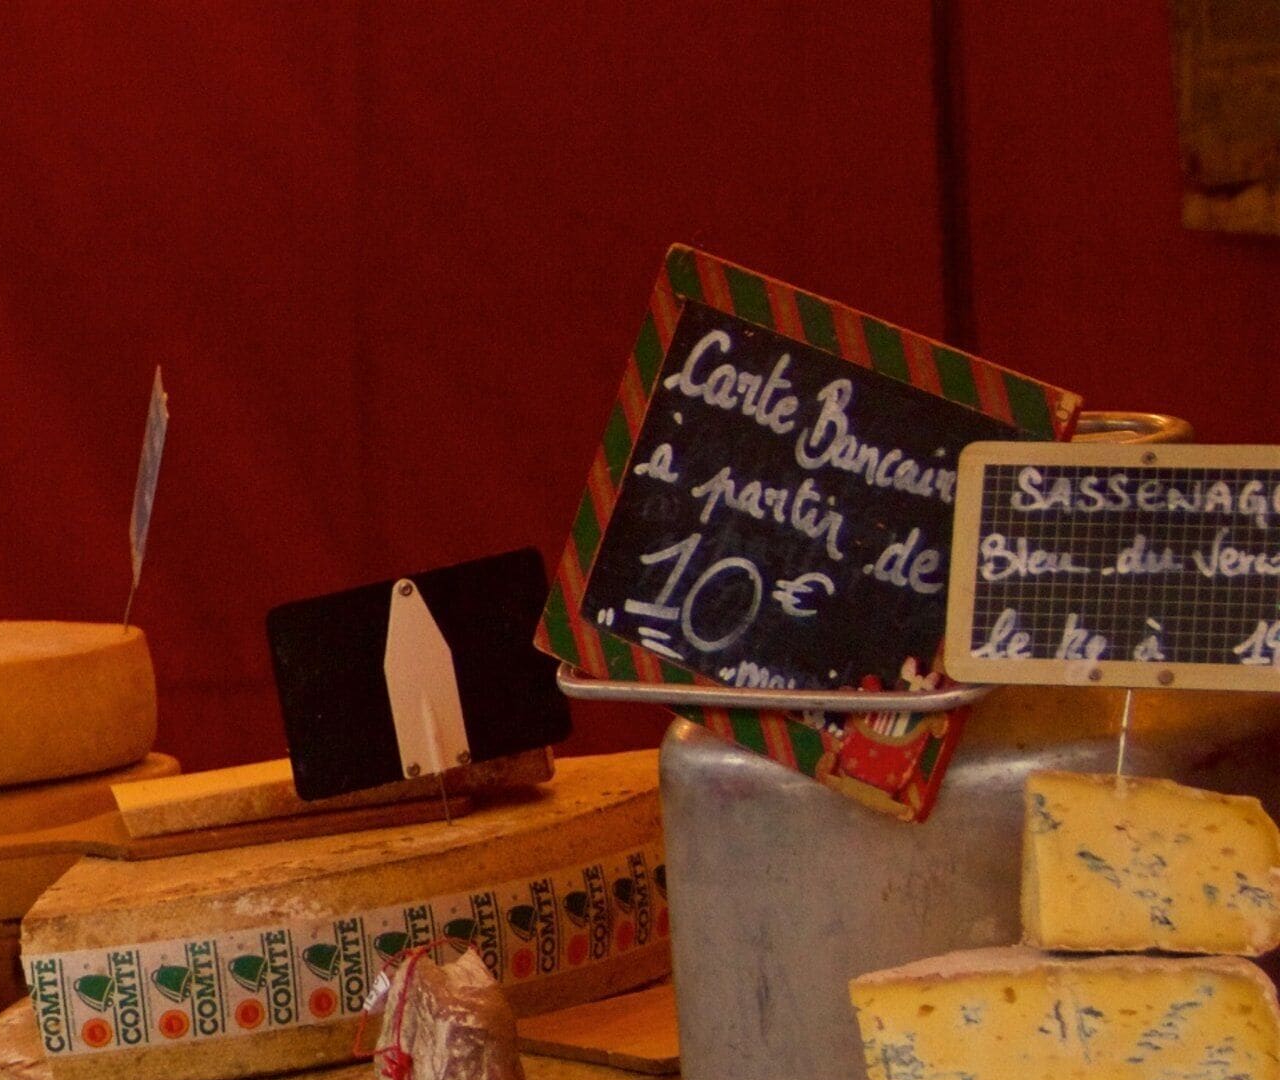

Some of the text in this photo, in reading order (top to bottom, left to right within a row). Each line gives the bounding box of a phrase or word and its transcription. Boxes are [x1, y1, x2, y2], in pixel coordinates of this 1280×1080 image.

[664, 330, 957, 502] Carte Bancair
[692, 465, 844, 561] partir
[862, 527, 945, 595] de
[1011, 466, 1280, 529] SASSENAG
[980, 533, 1095, 581] Bleu
[113, 950, 142, 1045] COMTÉ
[190, 939, 220, 1036] COMTÉ
[265, 929, 294, 1026] COMTÉ
